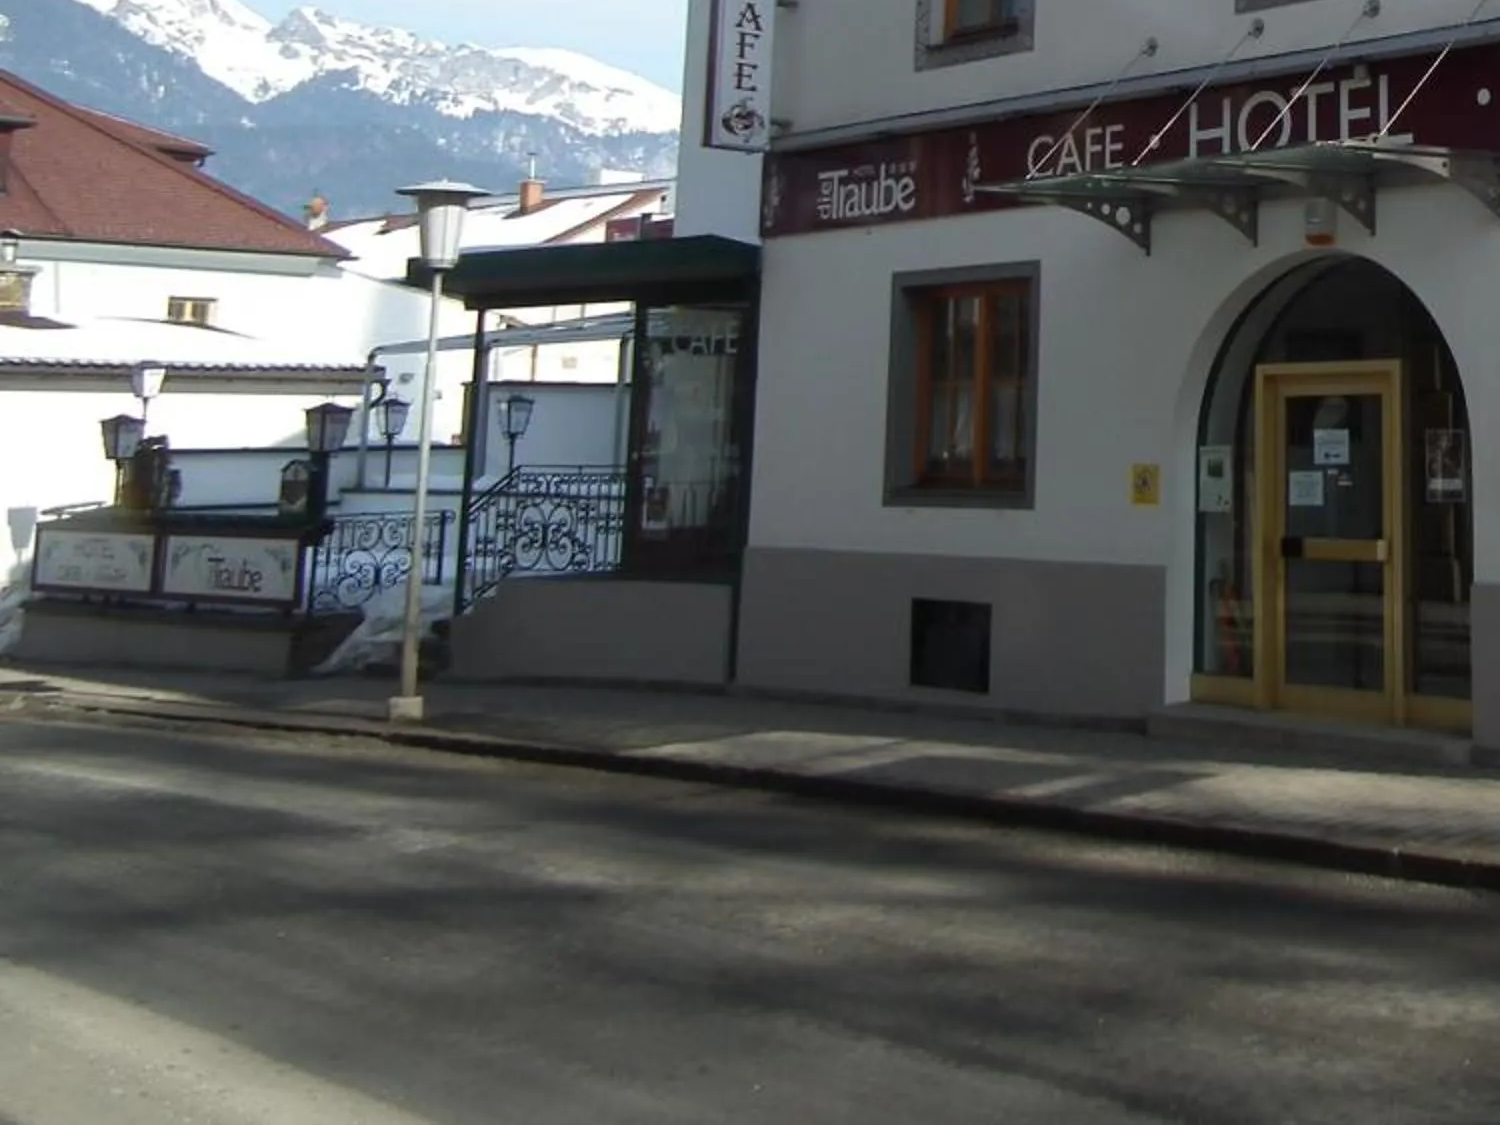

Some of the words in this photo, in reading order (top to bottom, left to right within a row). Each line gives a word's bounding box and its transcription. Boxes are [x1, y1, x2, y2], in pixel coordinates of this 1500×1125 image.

[1026, 123, 1125, 178] CAFE
[1184, 72, 1414, 162] HOTEL
[818, 161, 917, 220] Traube
